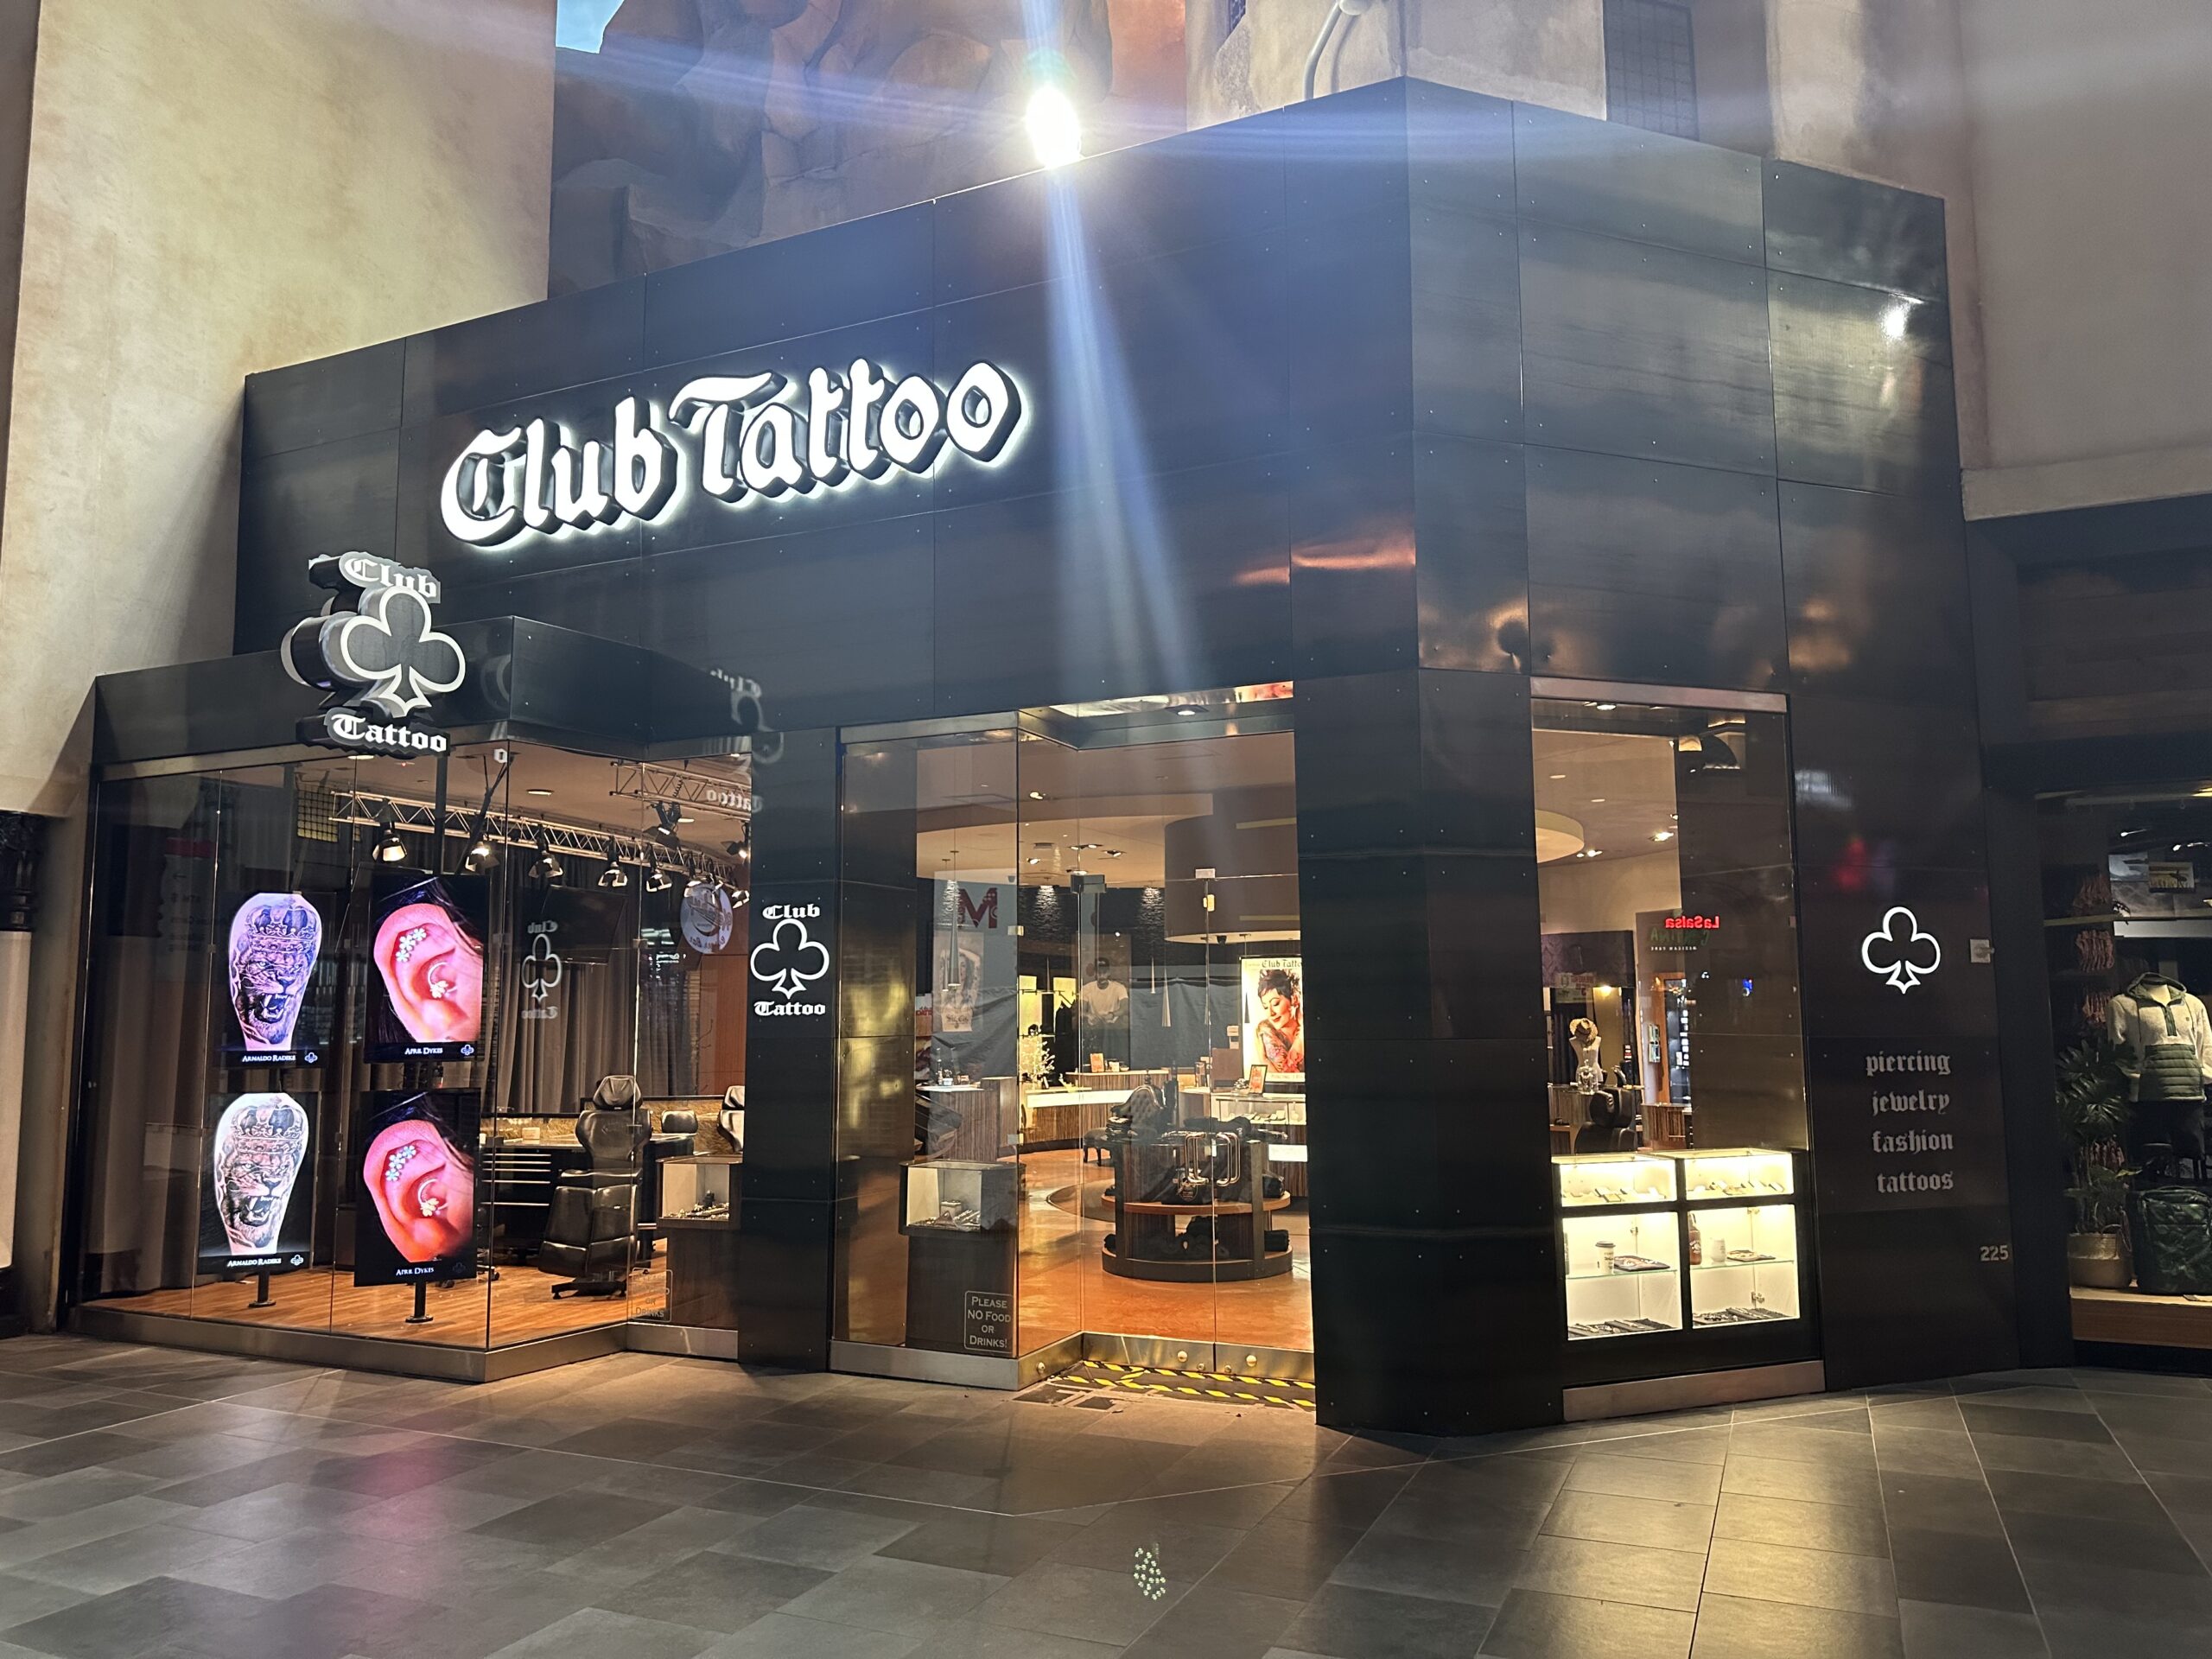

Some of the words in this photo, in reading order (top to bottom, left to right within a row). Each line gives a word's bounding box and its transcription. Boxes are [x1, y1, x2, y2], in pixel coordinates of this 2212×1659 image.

[441, 395, 674, 544] Club
[669, 358, 1018, 501] Tattoo
[345, 558, 437, 598] Club
[331, 715, 448, 753] Tattoo
[762, 904, 821, 919] Club
[1262, 959, 1281, 968] Club
[753, 1001, 826, 1016] Tattoo
[1866, 1050, 1951, 1077] piercing
[1872, 1090, 1950, 1116] jewelry
[1872, 1128, 1954, 1155] fashion
[1877, 1170, 1954, 1194] tattoos
[1980, 1245, 2009, 1262] 225
[971, 1295, 1008, 1309] PLEASE
[967, 1309, 983, 1320] NO
[985, 1311, 1012, 1323] FOOD
[981, 1325, 995, 1333] OR
[969, 1335, 1008, 1348] DRINKS!
